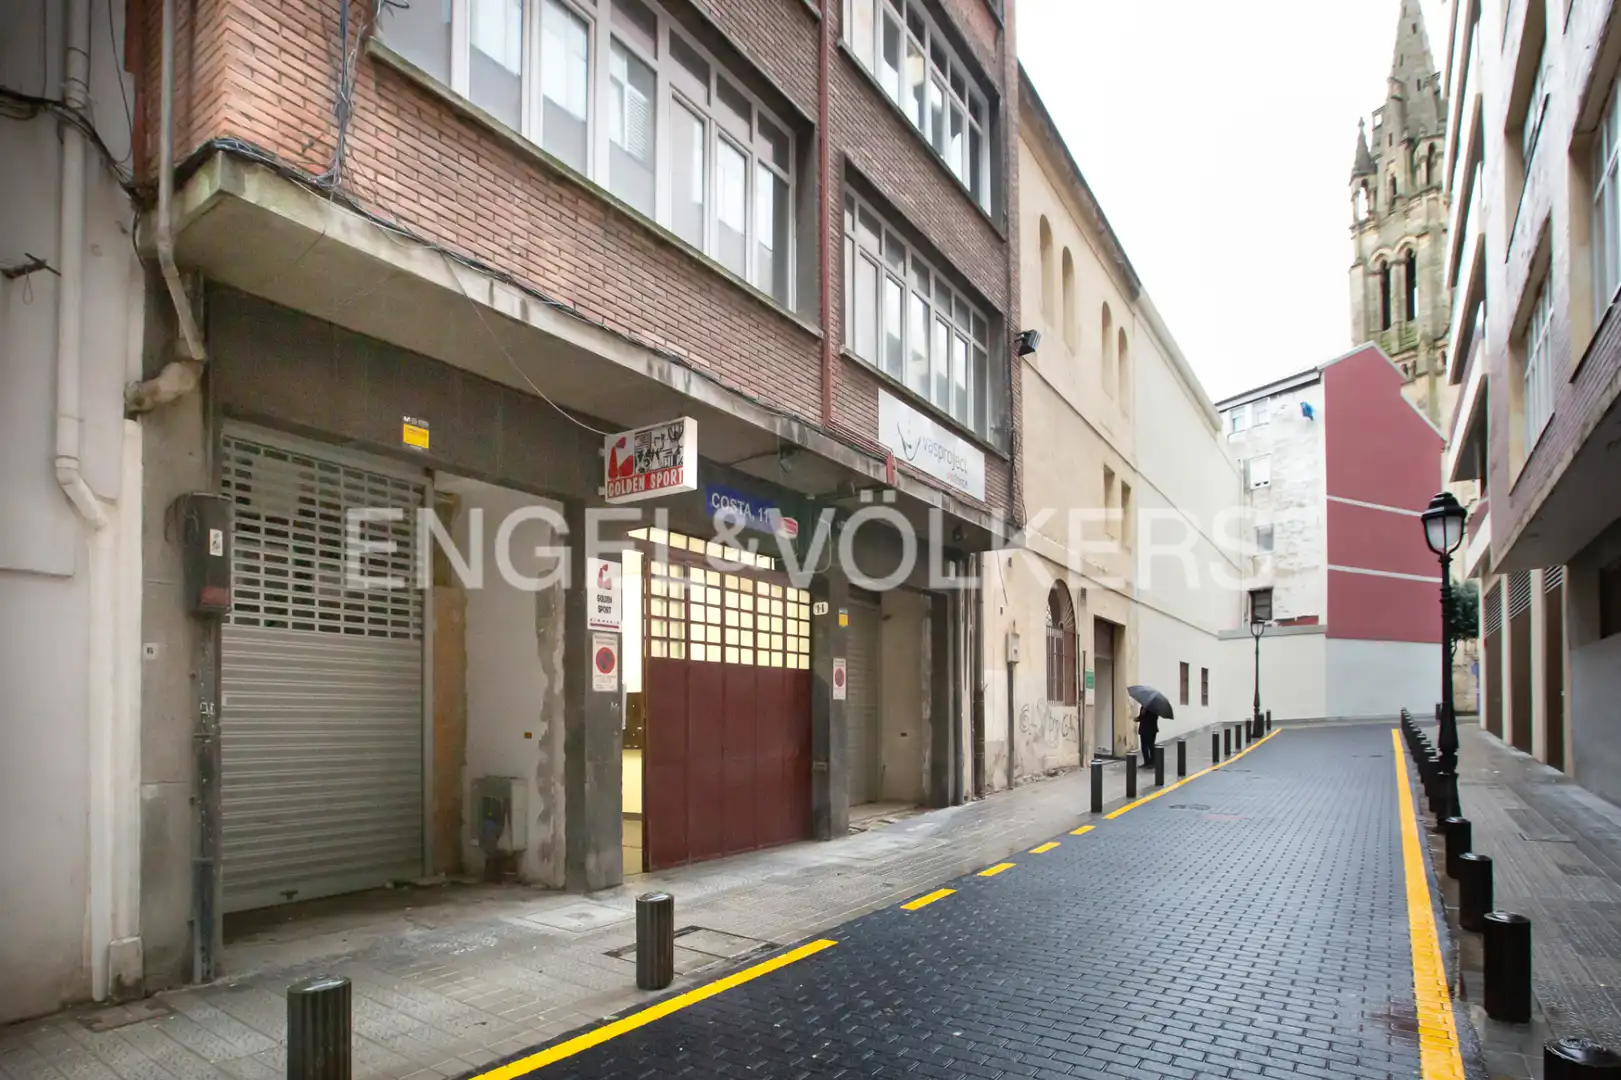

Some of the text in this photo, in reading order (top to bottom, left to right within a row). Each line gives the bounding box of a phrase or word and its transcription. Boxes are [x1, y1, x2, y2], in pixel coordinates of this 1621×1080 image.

[608, 468, 684, 497] GOLDEN SPORT
[598, 605, 612, 614] SPORT
